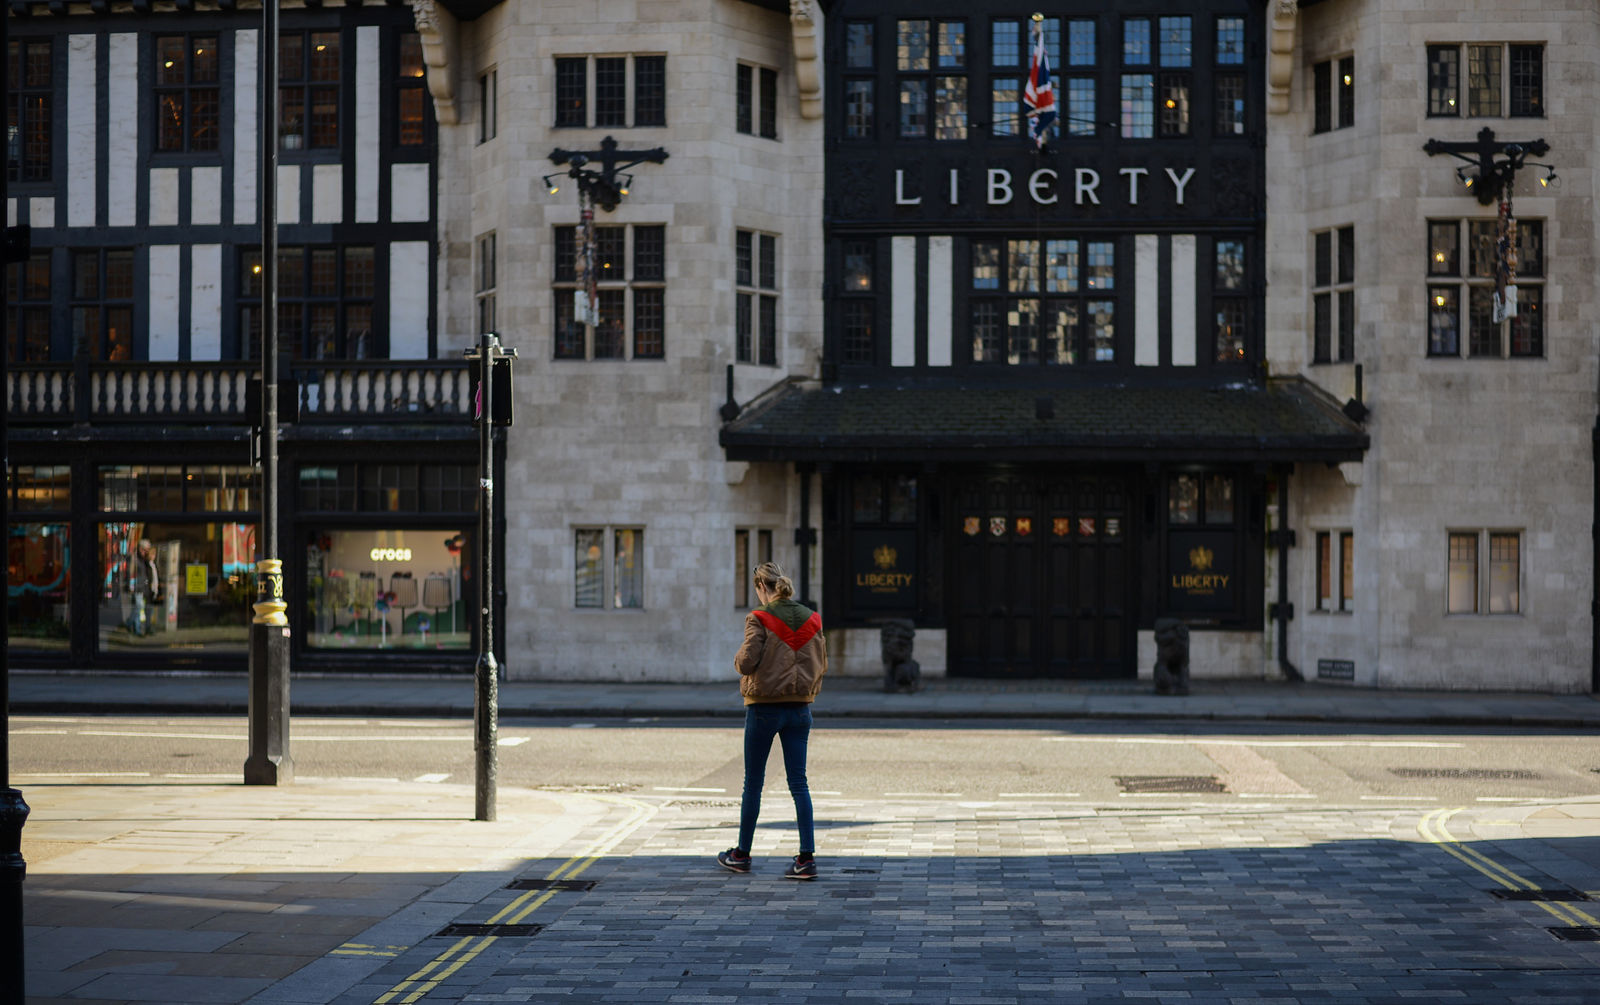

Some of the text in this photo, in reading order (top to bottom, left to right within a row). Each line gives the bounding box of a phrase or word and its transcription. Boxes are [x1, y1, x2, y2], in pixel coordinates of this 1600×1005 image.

[895, 167, 1196, 205] LIBERTY
[370, 548, 412, 561] crocs
[856, 573, 913, 586] LIBERTY
[1172, 575, 1229, 588] LIBERTY
